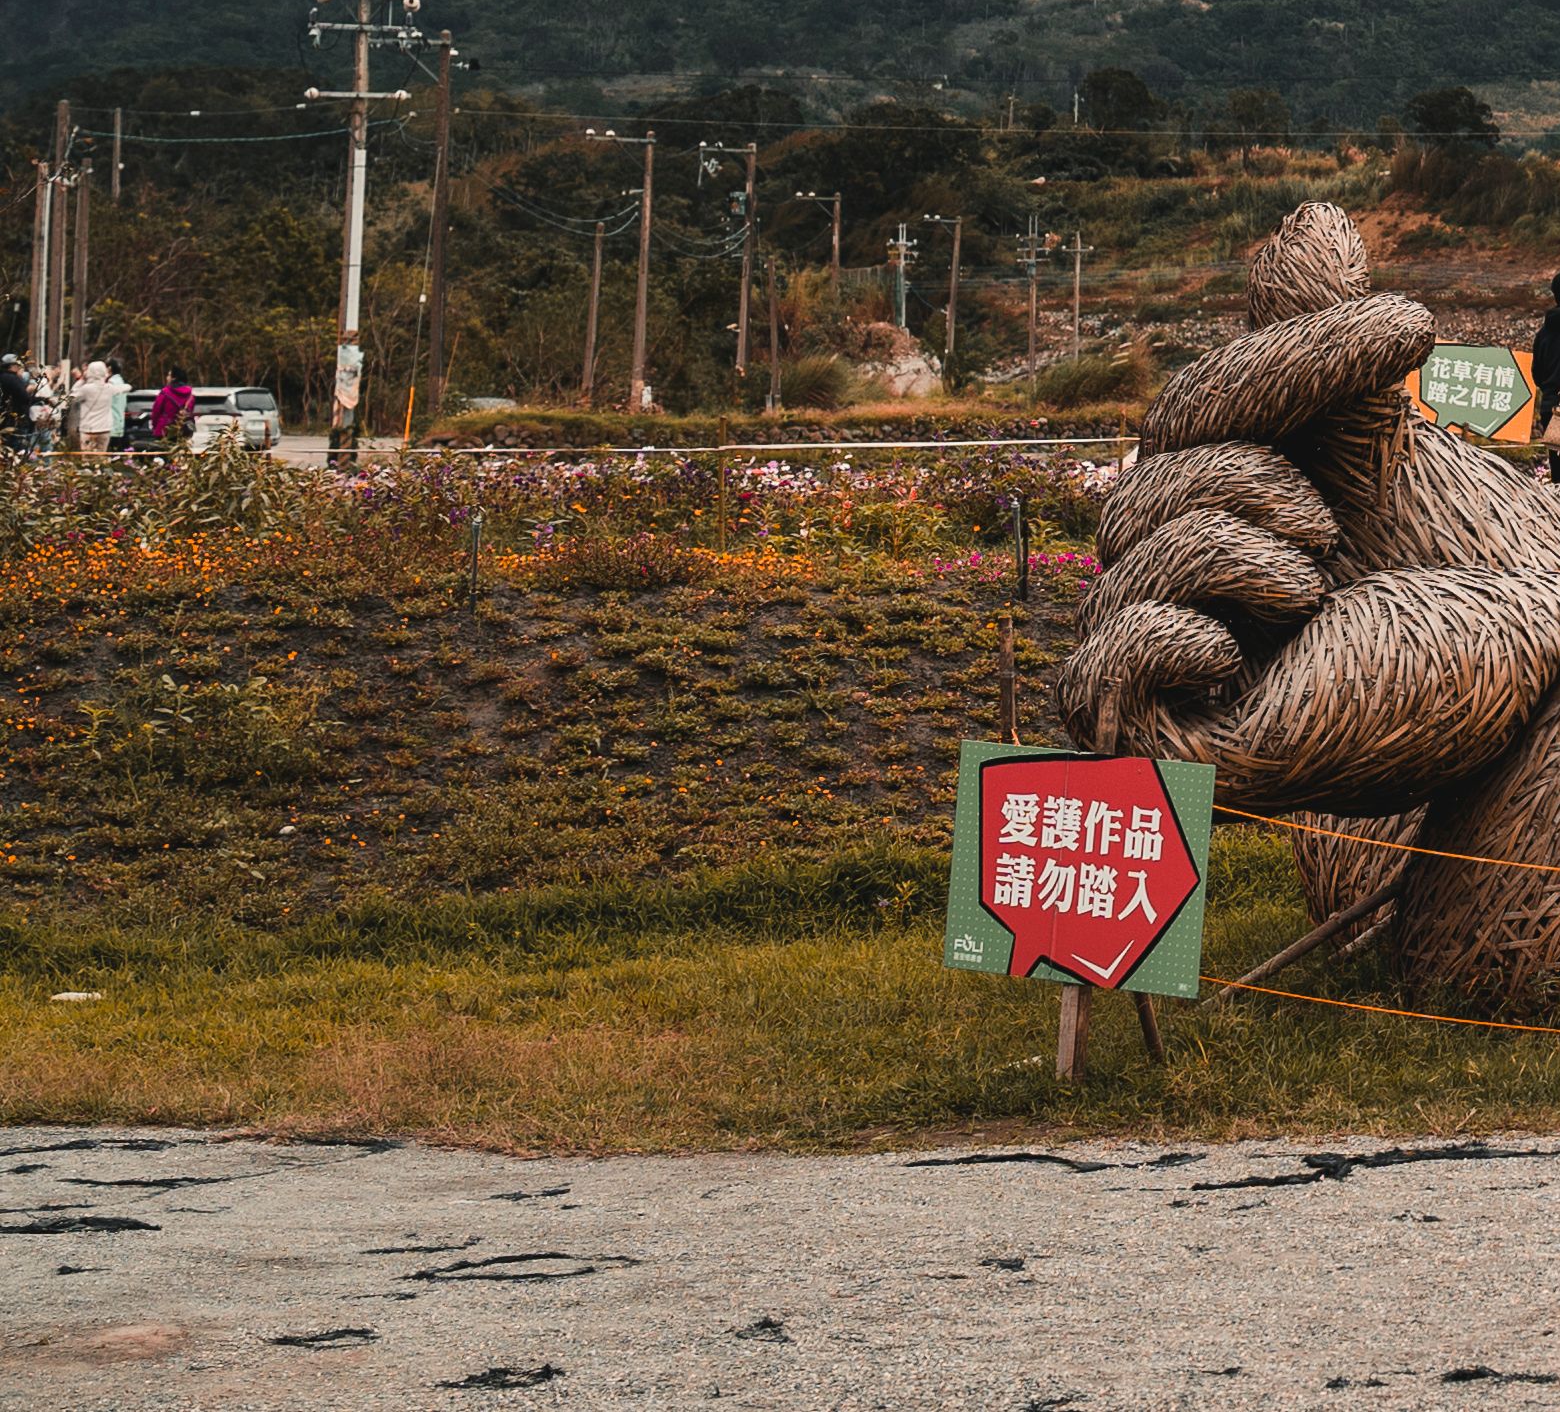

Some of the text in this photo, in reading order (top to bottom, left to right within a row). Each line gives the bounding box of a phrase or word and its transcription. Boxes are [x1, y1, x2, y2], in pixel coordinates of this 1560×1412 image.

[1430, 356, 1516, 389] 花草有情
[1426, 381, 1513, 412] 踏之何忍
[998, 793, 1164, 862] 愛護作品
[993, 853, 1159, 925] 請勿踏入
[953, 937, 984, 954] FULI
